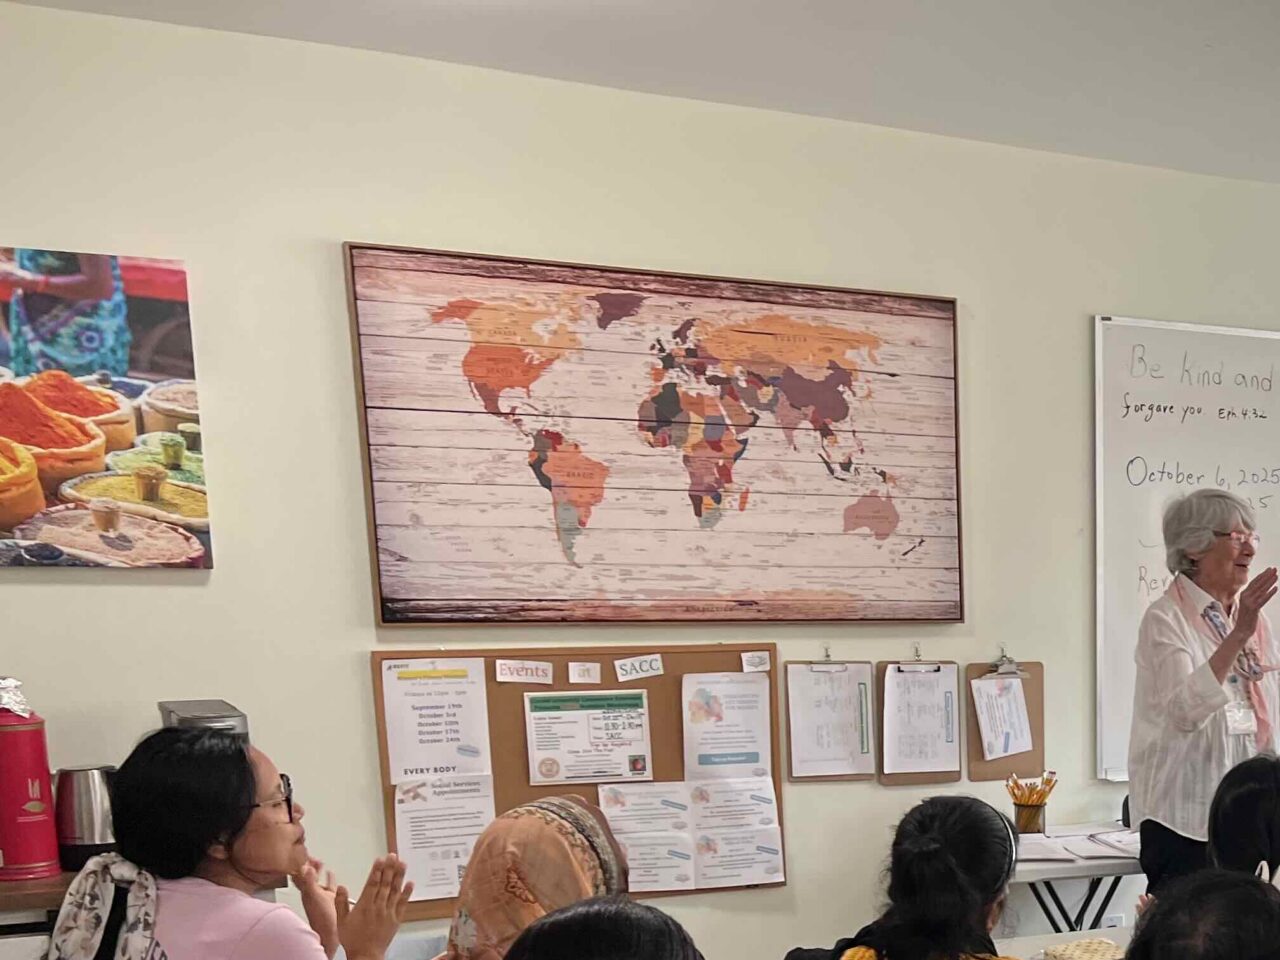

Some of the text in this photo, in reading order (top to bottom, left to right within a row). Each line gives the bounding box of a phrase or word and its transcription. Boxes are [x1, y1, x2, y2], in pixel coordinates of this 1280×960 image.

[1130, 343, 1164, 379] Be
[1233, 361, 1273, 393] and
[1122, 392, 1174, 422] forgave
[1126, 456, 1204, 486] October
[499, 663, 549, 679] Events
[619, 658, 661, 677] SACC
[411, 703, 445, 711] September
[404, 767, 431, 775] EVERY
